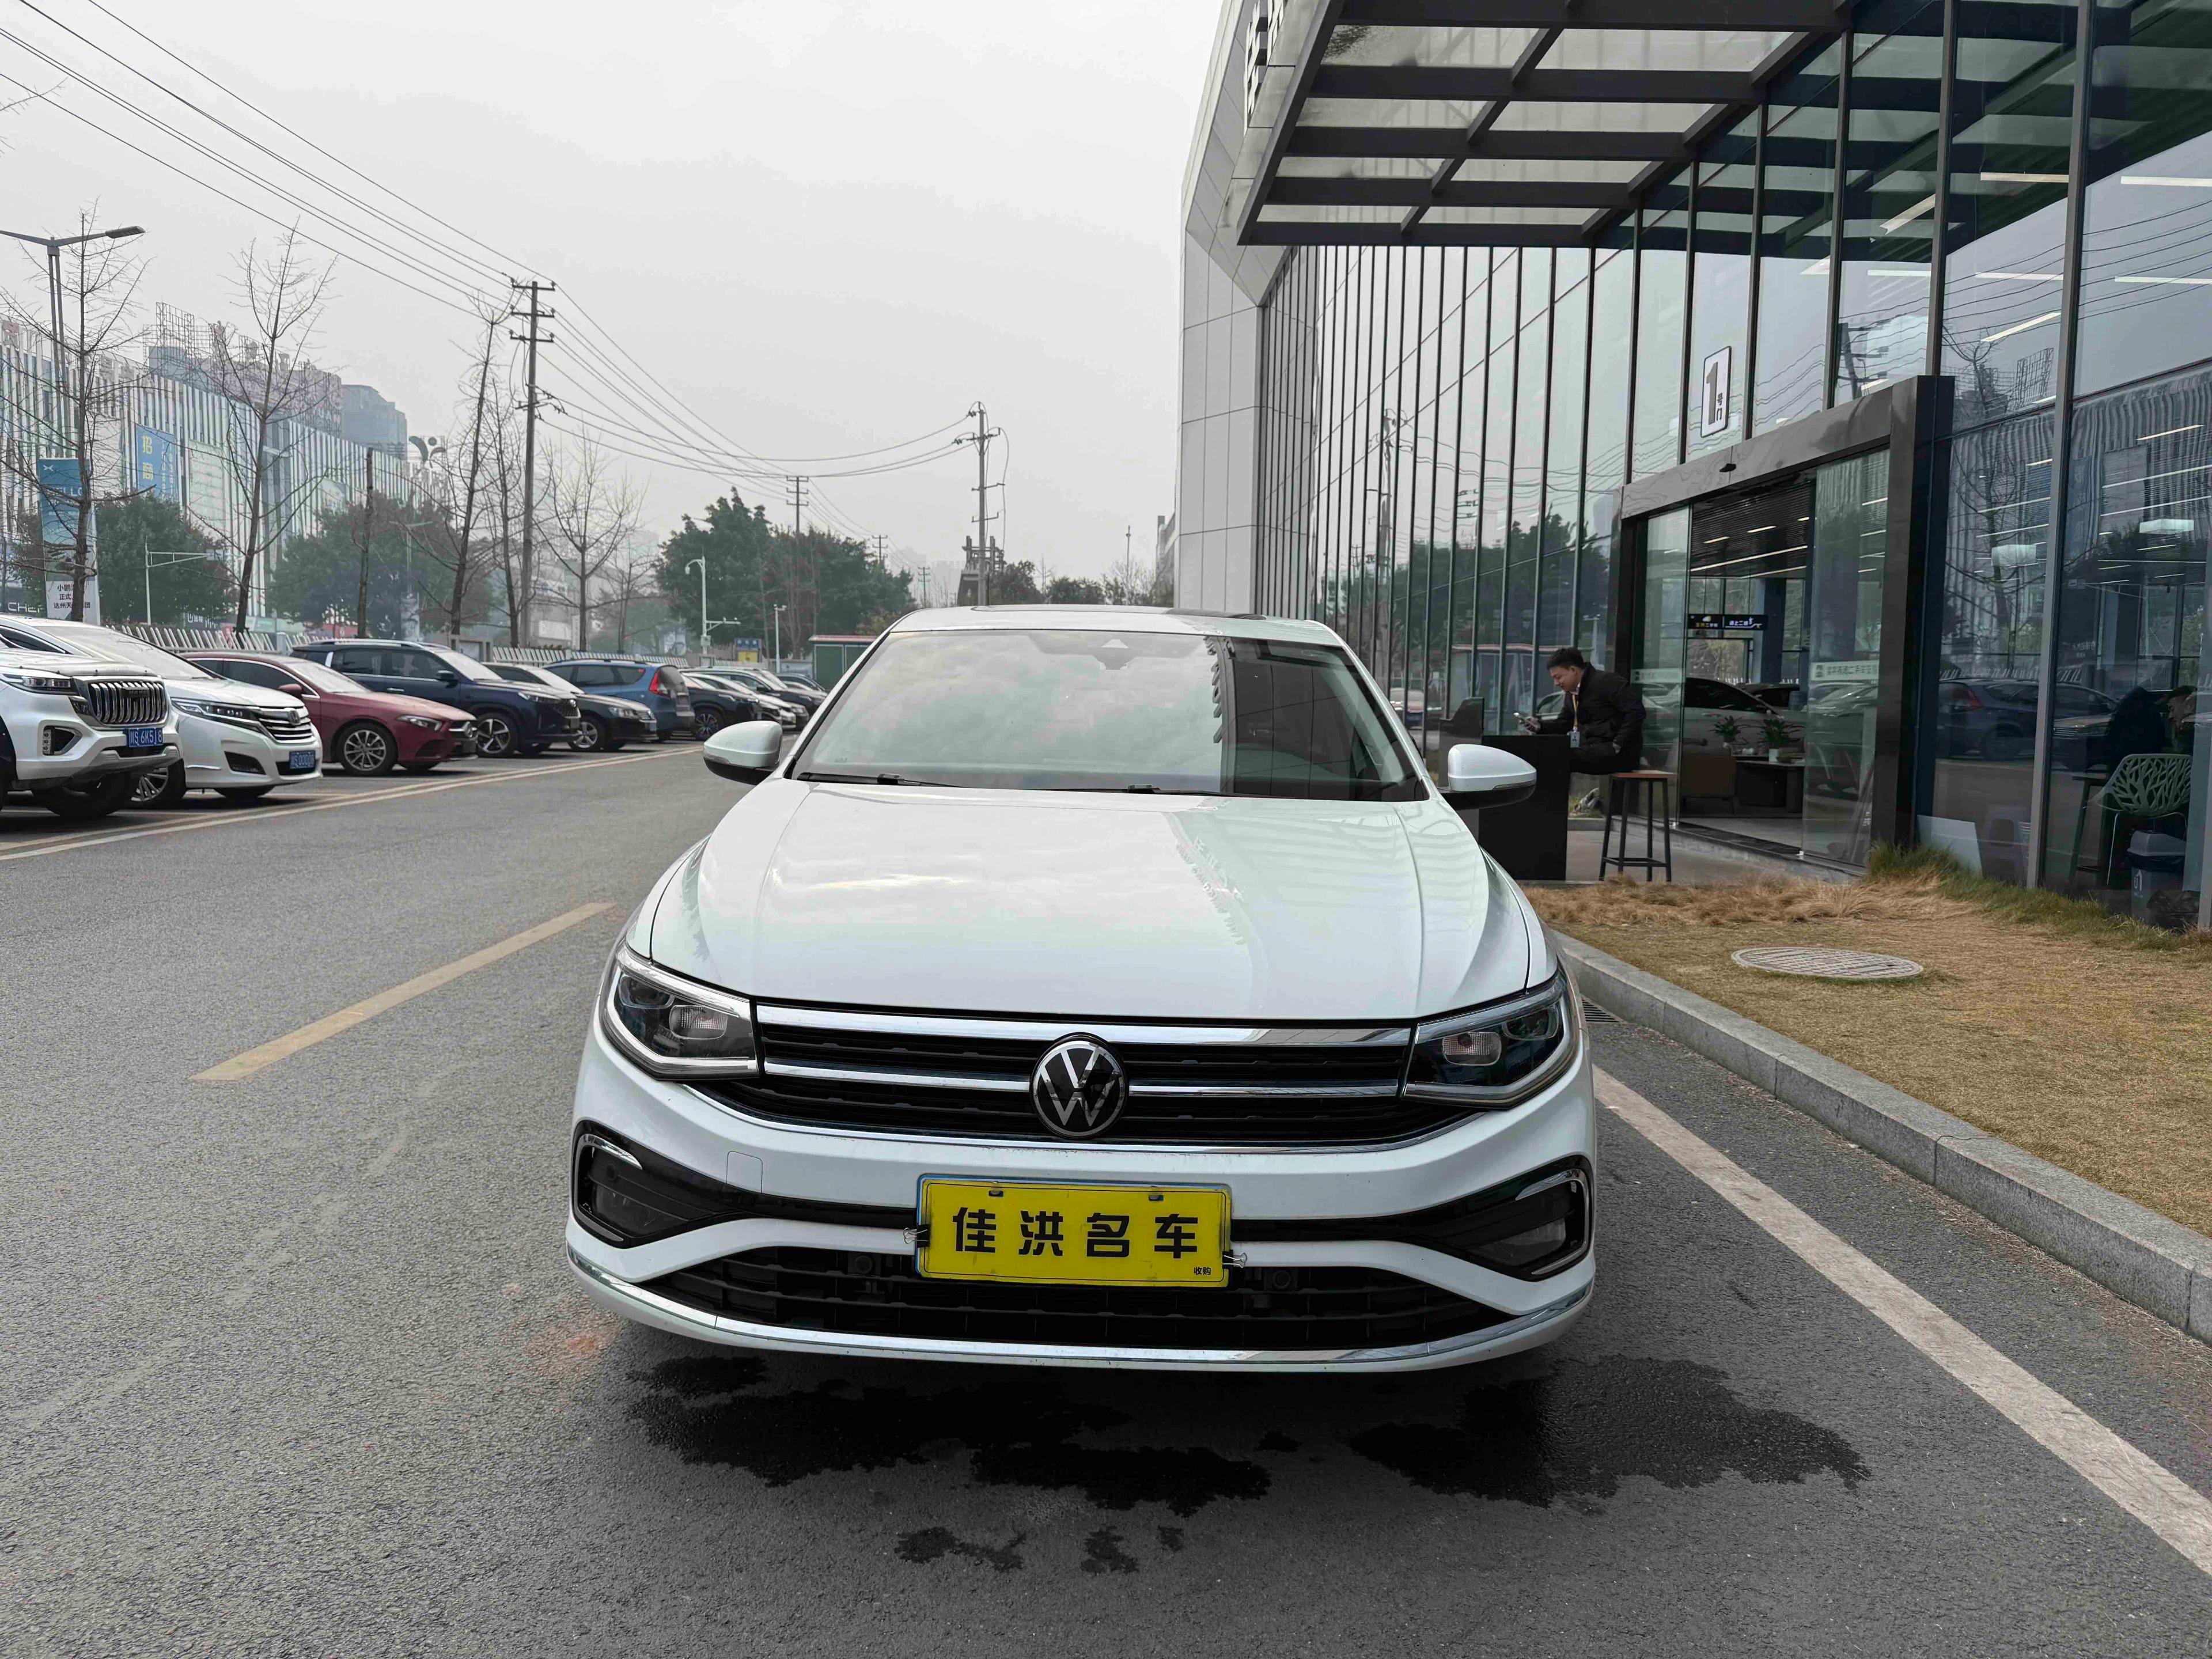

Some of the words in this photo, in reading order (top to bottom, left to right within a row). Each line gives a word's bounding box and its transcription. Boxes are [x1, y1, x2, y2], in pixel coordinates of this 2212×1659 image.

[1706, 362, 1718, 425] 1
[142, 435, 154, 481] 招商
[952, 1207, 1199, 1259] 佳洪名车
[1194, 1267, 1211, 1275] 收购
